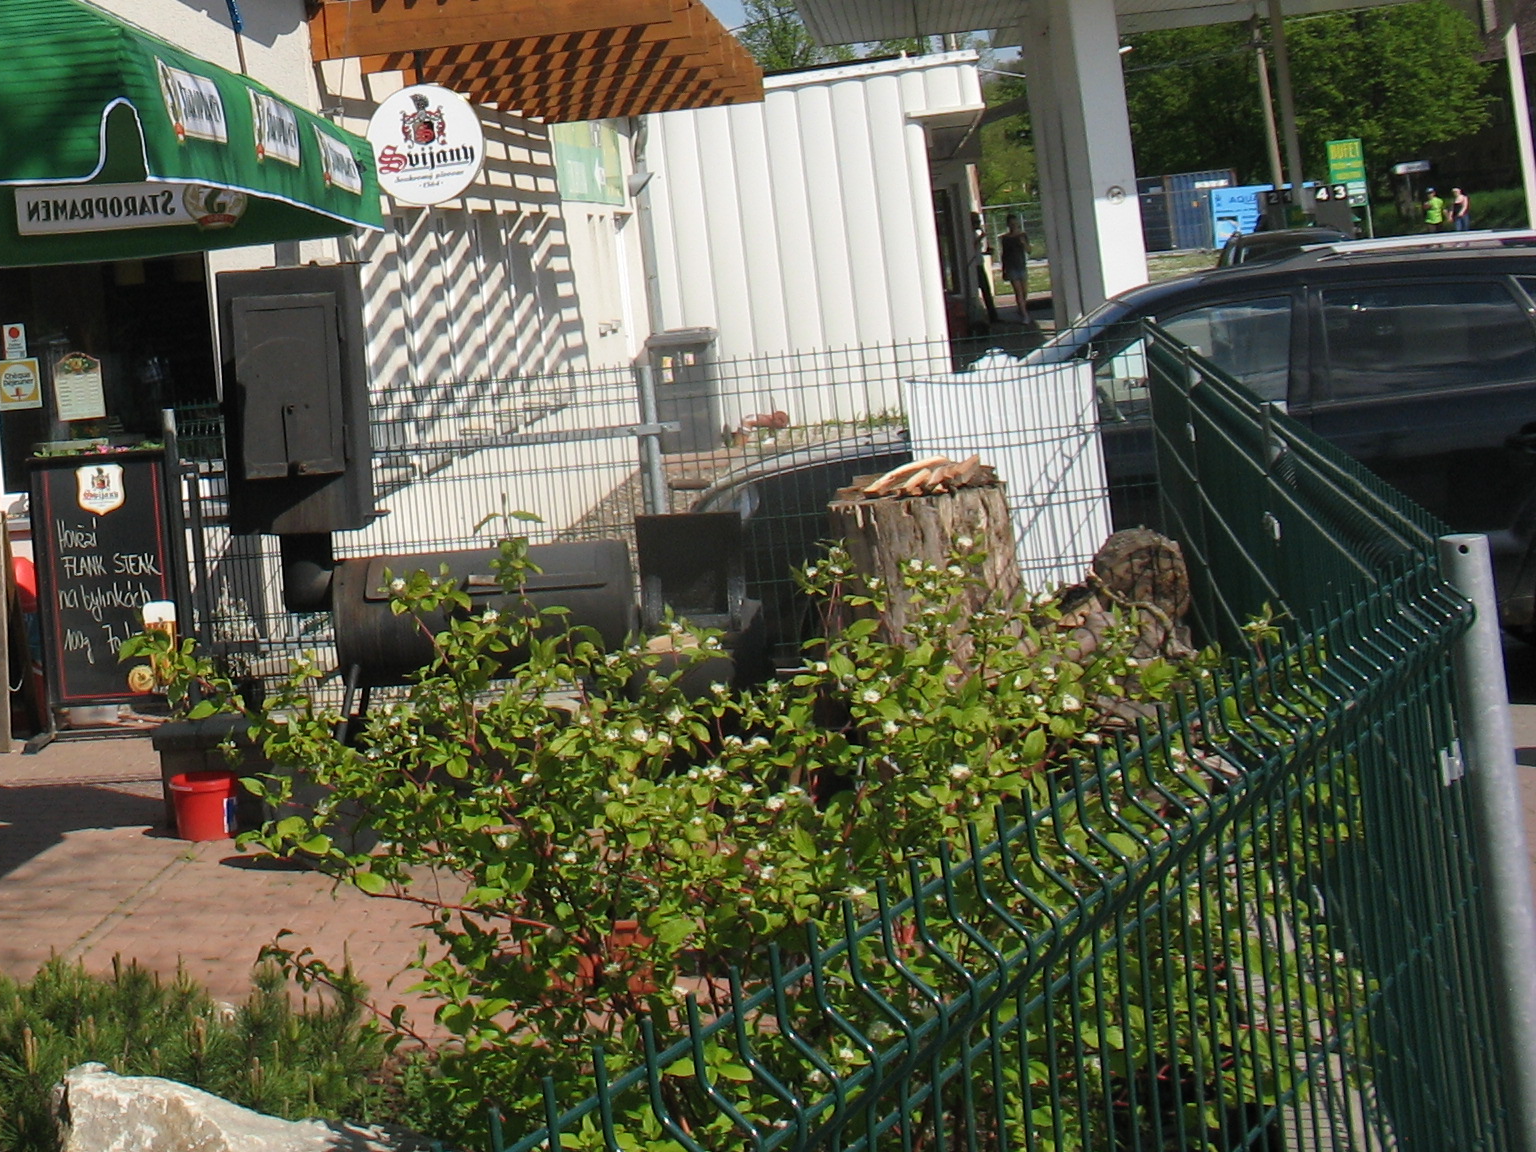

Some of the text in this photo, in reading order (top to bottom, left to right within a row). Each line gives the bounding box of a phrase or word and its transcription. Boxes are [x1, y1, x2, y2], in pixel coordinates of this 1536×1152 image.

[378, 145, 475, 175] Svijany
[1269, 193, 1278, 204] 2
[1315, 187, 1329, 200] 4
[1333, 185, 1346, 199] 3
[56, 517, 97, 553] Hovězí
[61, 552, 163, 578] FLANK STEAK
[58, 580, 152, 623] na bylinkách
[64, 628, 95, 664] 100g
